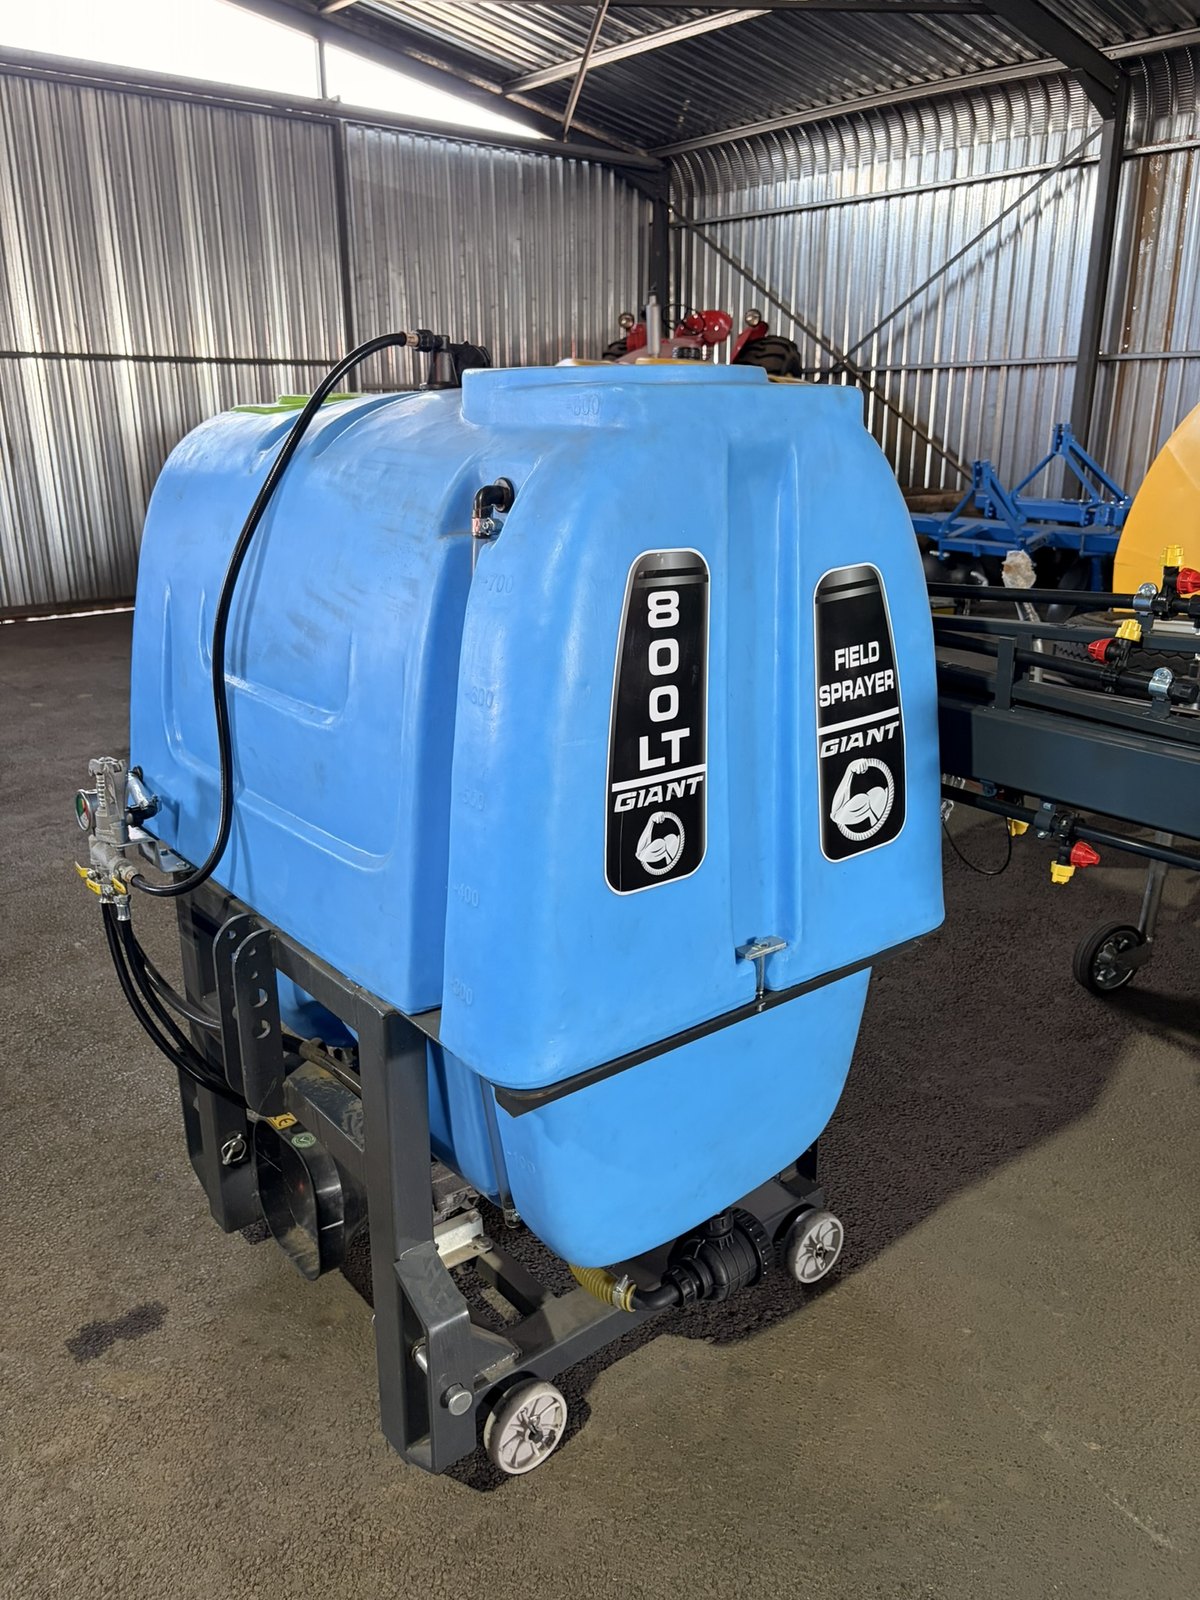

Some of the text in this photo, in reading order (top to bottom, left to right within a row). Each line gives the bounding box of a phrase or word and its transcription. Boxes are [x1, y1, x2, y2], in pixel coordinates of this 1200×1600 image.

[834, 640, 880, 672] FIELD
[819, 668, 895, 709] SPRAYER
[820, 720, 900, 760] GIANT
[613, 774, 705, 813] GIANT
